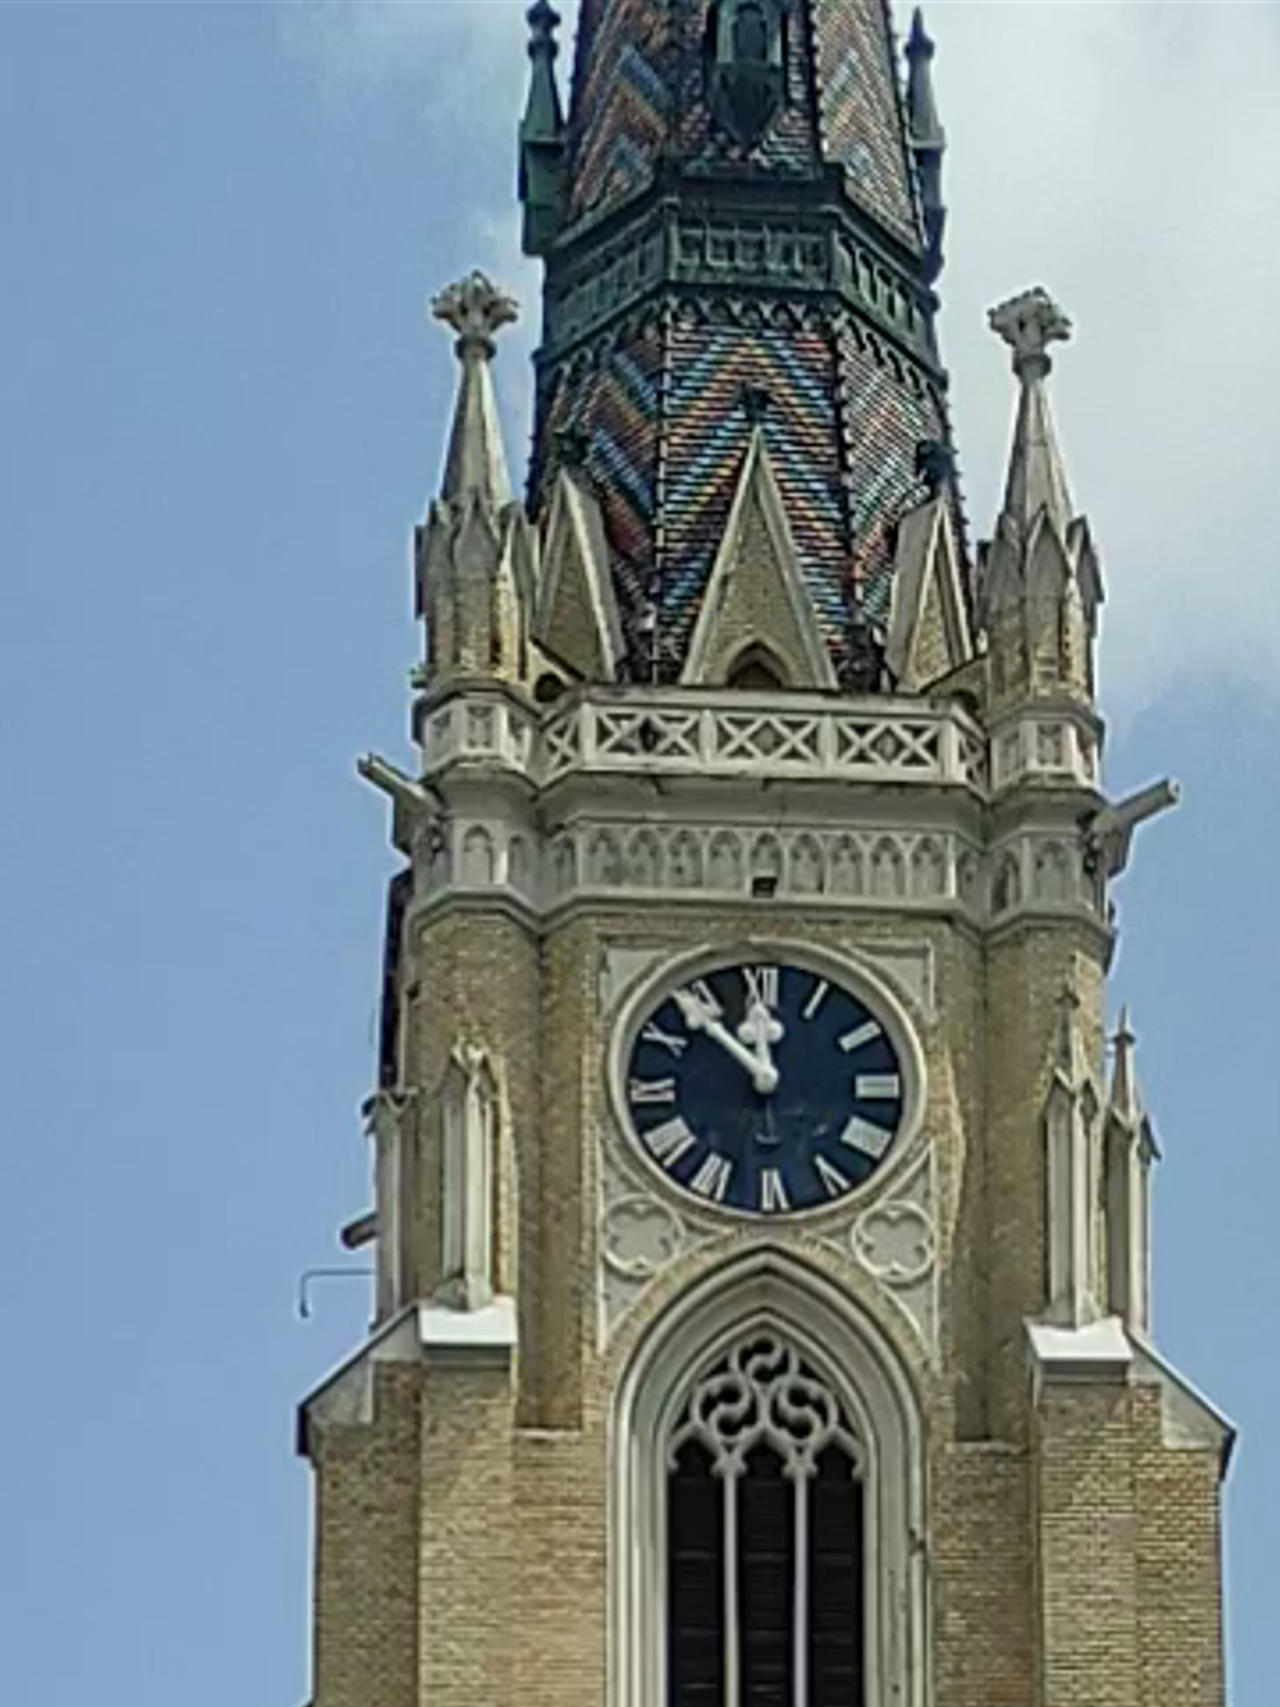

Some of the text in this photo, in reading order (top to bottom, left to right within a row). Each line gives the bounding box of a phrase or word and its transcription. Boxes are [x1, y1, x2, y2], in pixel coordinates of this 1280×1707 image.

[641, 1020, 687, 1058] X
[838, 1020, 881, 1052] II
[630, 1077, 675, 1102] IX
[855, 1074, 899, 1099] III
[761, 1168, 790, 1212] VI
[815, 1154, 851, 1196] V
